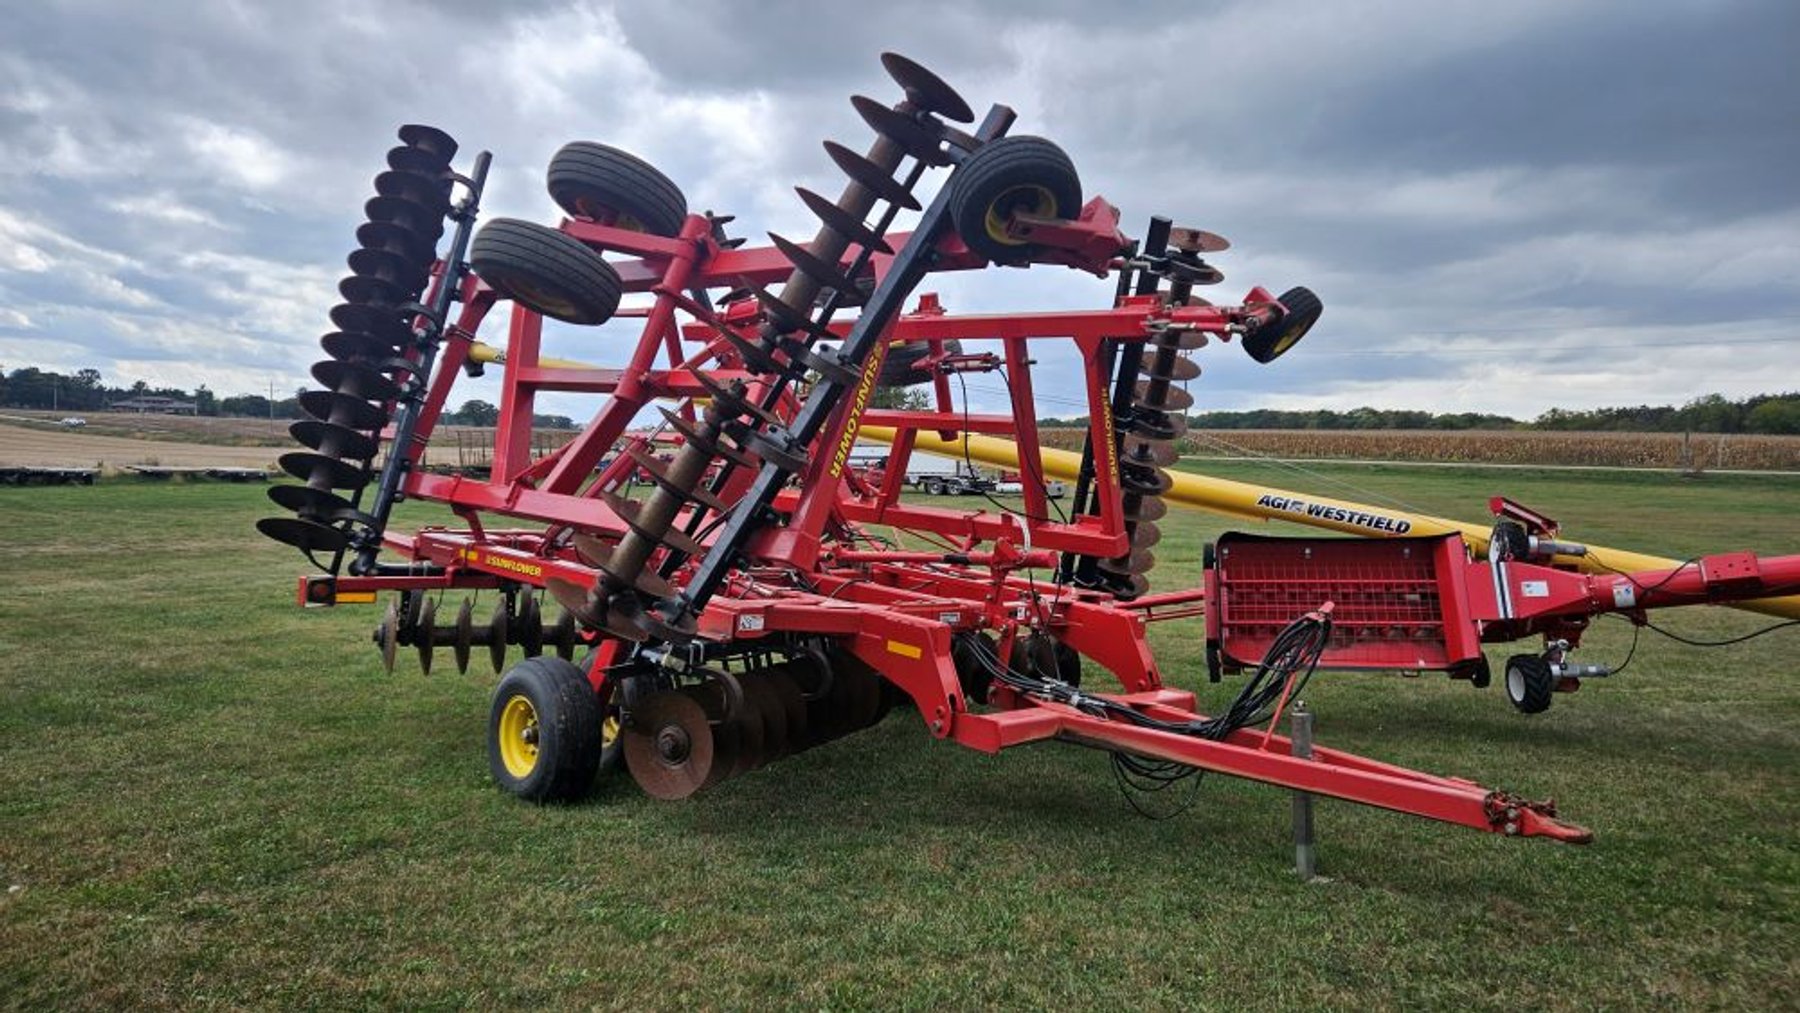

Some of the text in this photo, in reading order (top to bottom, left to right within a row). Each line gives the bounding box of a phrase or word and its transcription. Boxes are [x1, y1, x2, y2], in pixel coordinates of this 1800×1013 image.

[830, 356, 881, 478] SUNFLOWER
[1101, 388, 1118, 475] SUNFLOWER
[1257, 494, 1411, 534] AGI WESTFIELD
[490, 556, 541, 577] SUNFLOWER
